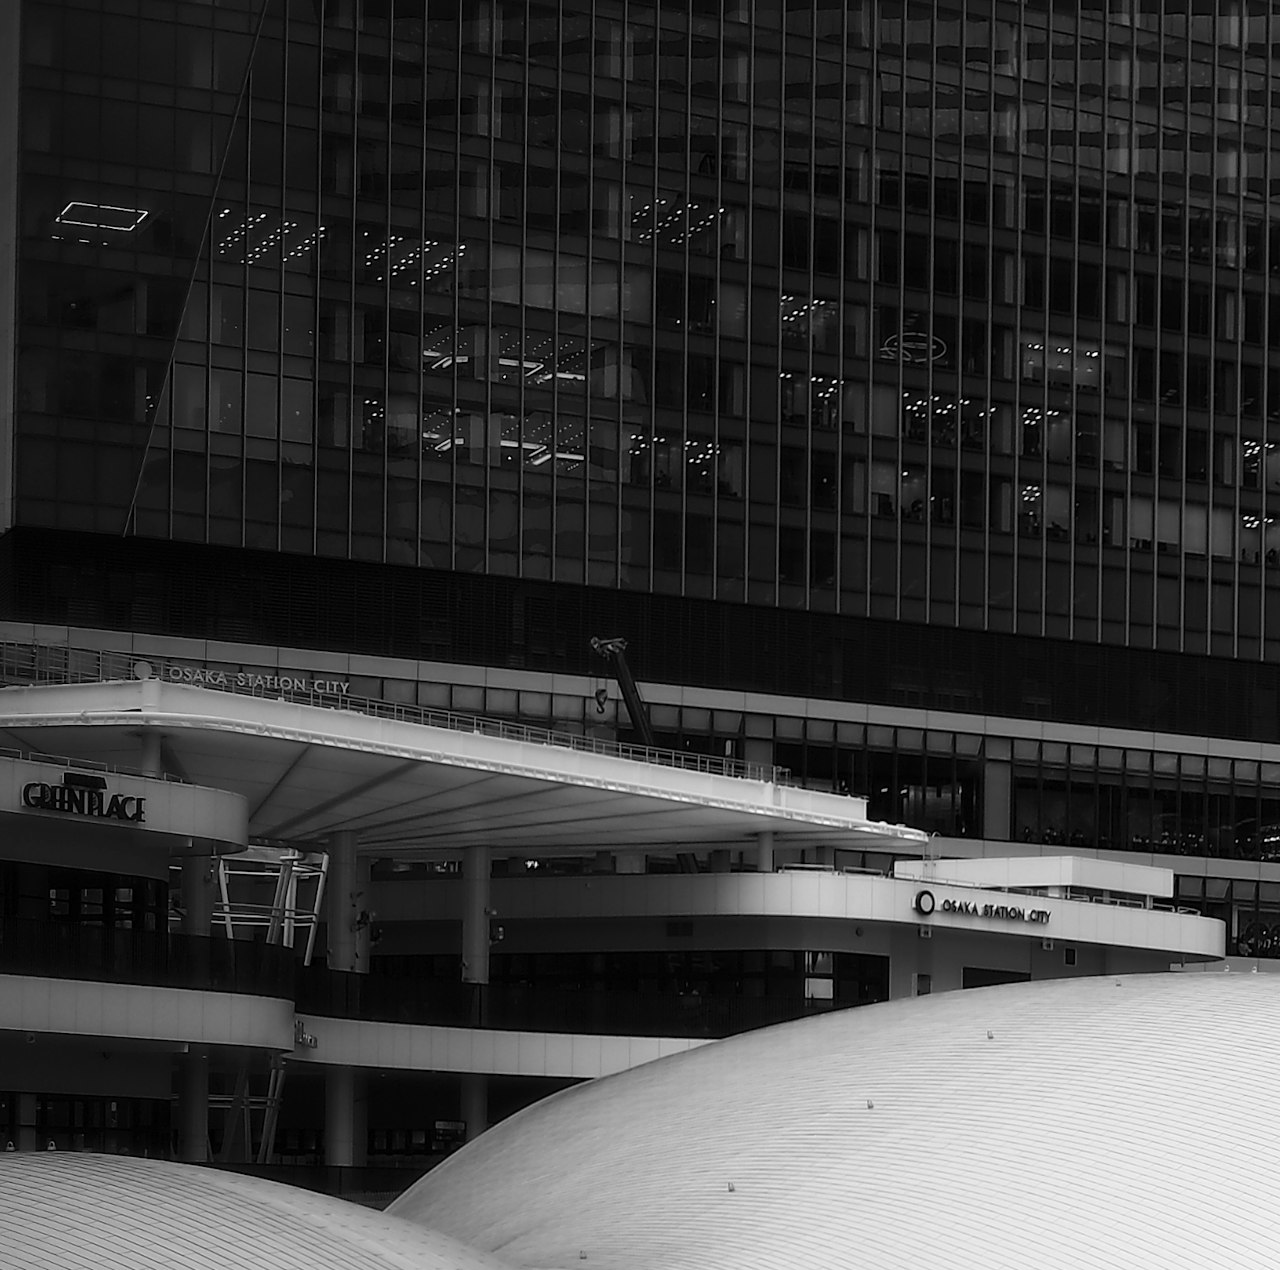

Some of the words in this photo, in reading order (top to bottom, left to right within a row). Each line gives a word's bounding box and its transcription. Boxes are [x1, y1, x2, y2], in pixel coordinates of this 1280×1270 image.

[168, 666, 228, 685] OSAKA
[236, 672, 306, 691] STATION
[313, 679, 350, 694] CITY
[942, 899, 979, 916] OSAKA
[983, 904, 1025, 920] STATION
[1029, 909, 1052, 923] CITY
